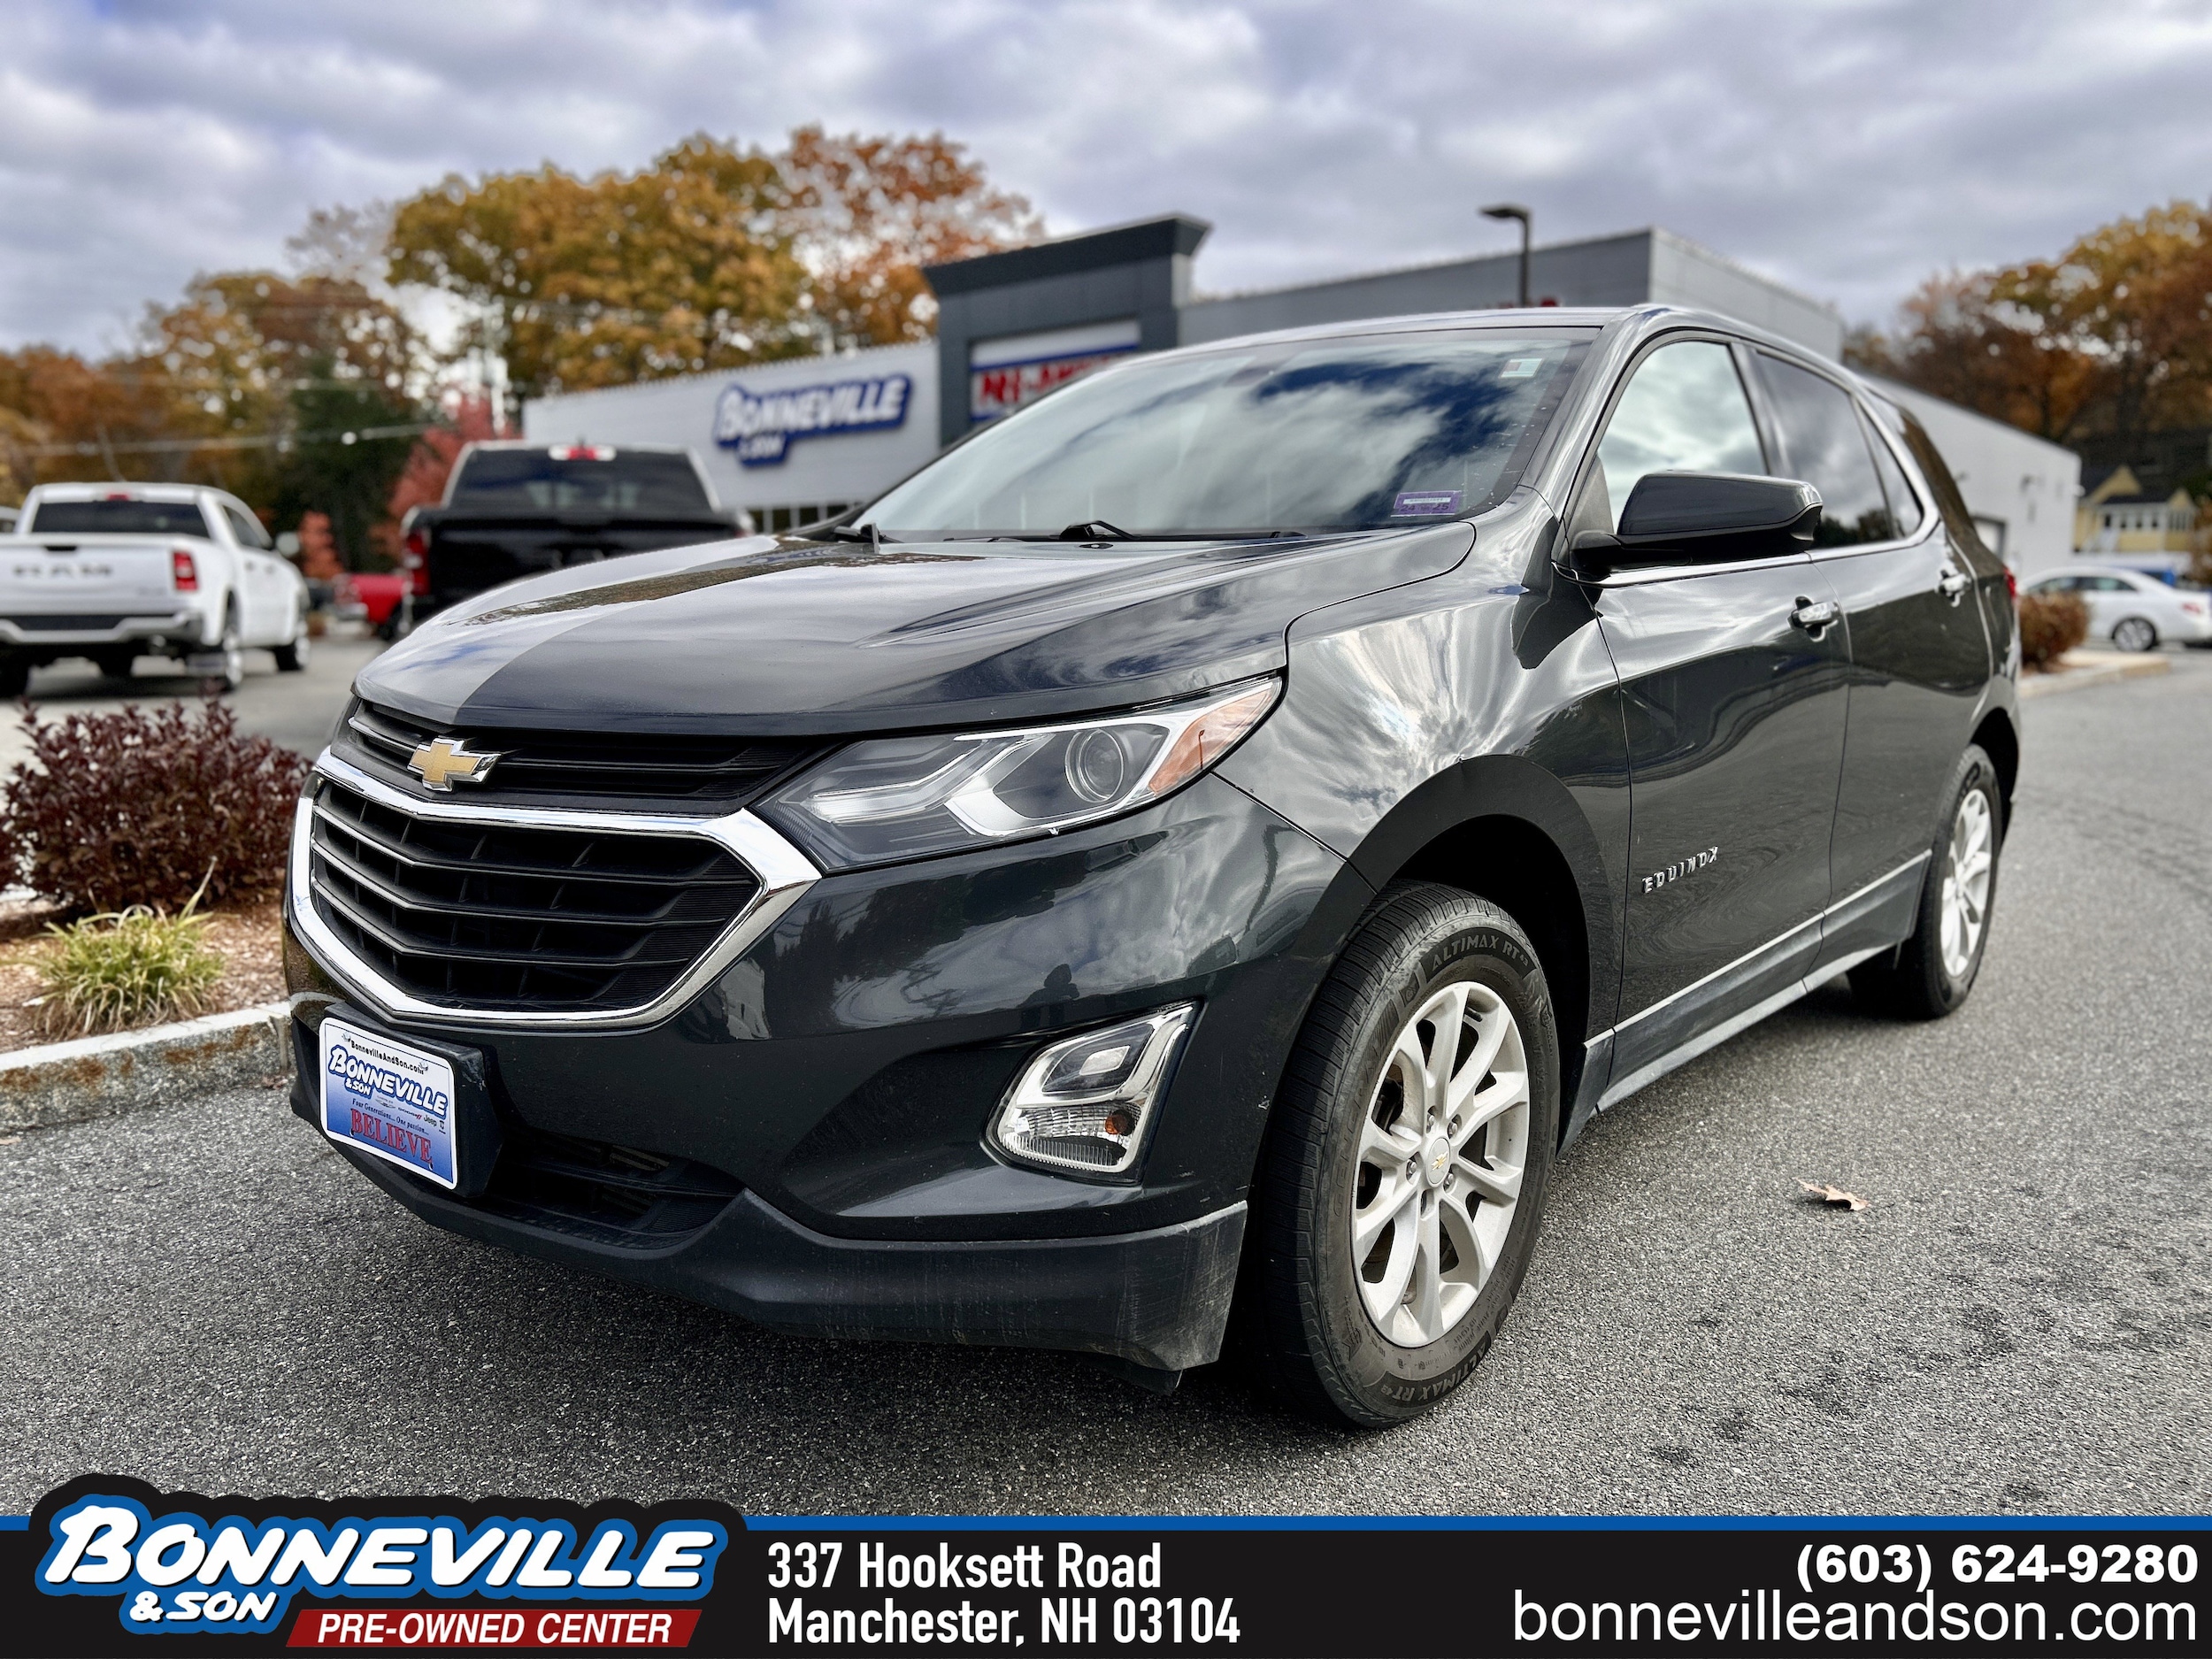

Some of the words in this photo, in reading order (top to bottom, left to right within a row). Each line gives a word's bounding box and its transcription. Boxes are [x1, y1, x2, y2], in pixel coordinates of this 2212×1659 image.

[718, 378, 907, 441] BONNEVILLE
[1641, 845, 1719, 895] EQUINOX
[1432, 933, 1500, 972] ALTIMAX
[329, 1047, 448, 1118] BONNEVILLE
[350, 1108, 434, 1164] BELIEVE
